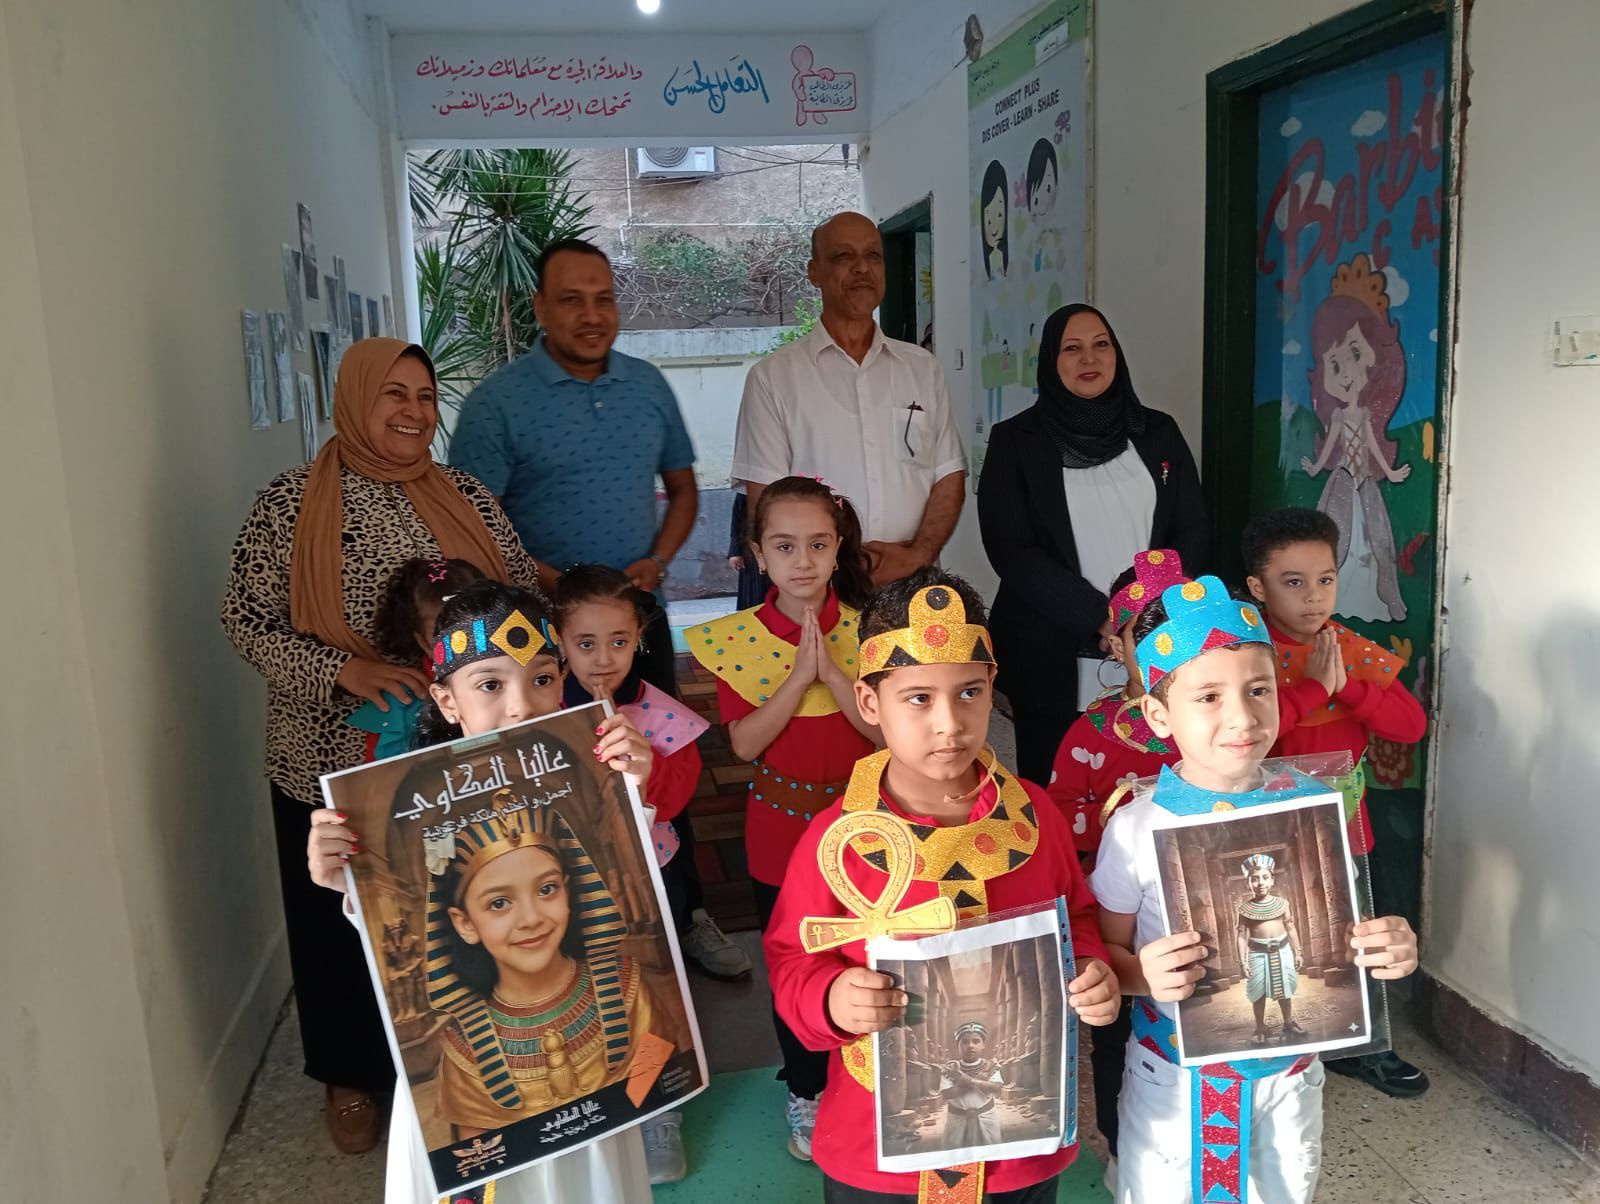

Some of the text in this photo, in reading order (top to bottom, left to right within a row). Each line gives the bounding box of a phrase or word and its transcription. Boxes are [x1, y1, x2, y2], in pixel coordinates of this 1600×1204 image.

[416, 55, 485, 81] وزميلاتك
[547, 63, 563, 80] مع
[585, 91, 632, 116] تمنحك
[995, 88, 1022, 116] CONNECT
[1023, 77, 1040, 99] PLUS
[1013, 103, 1033, 127] LEARN
[1037, 89, 1060, 113] SHARE
[517, 742, 572, 787] عاليا
